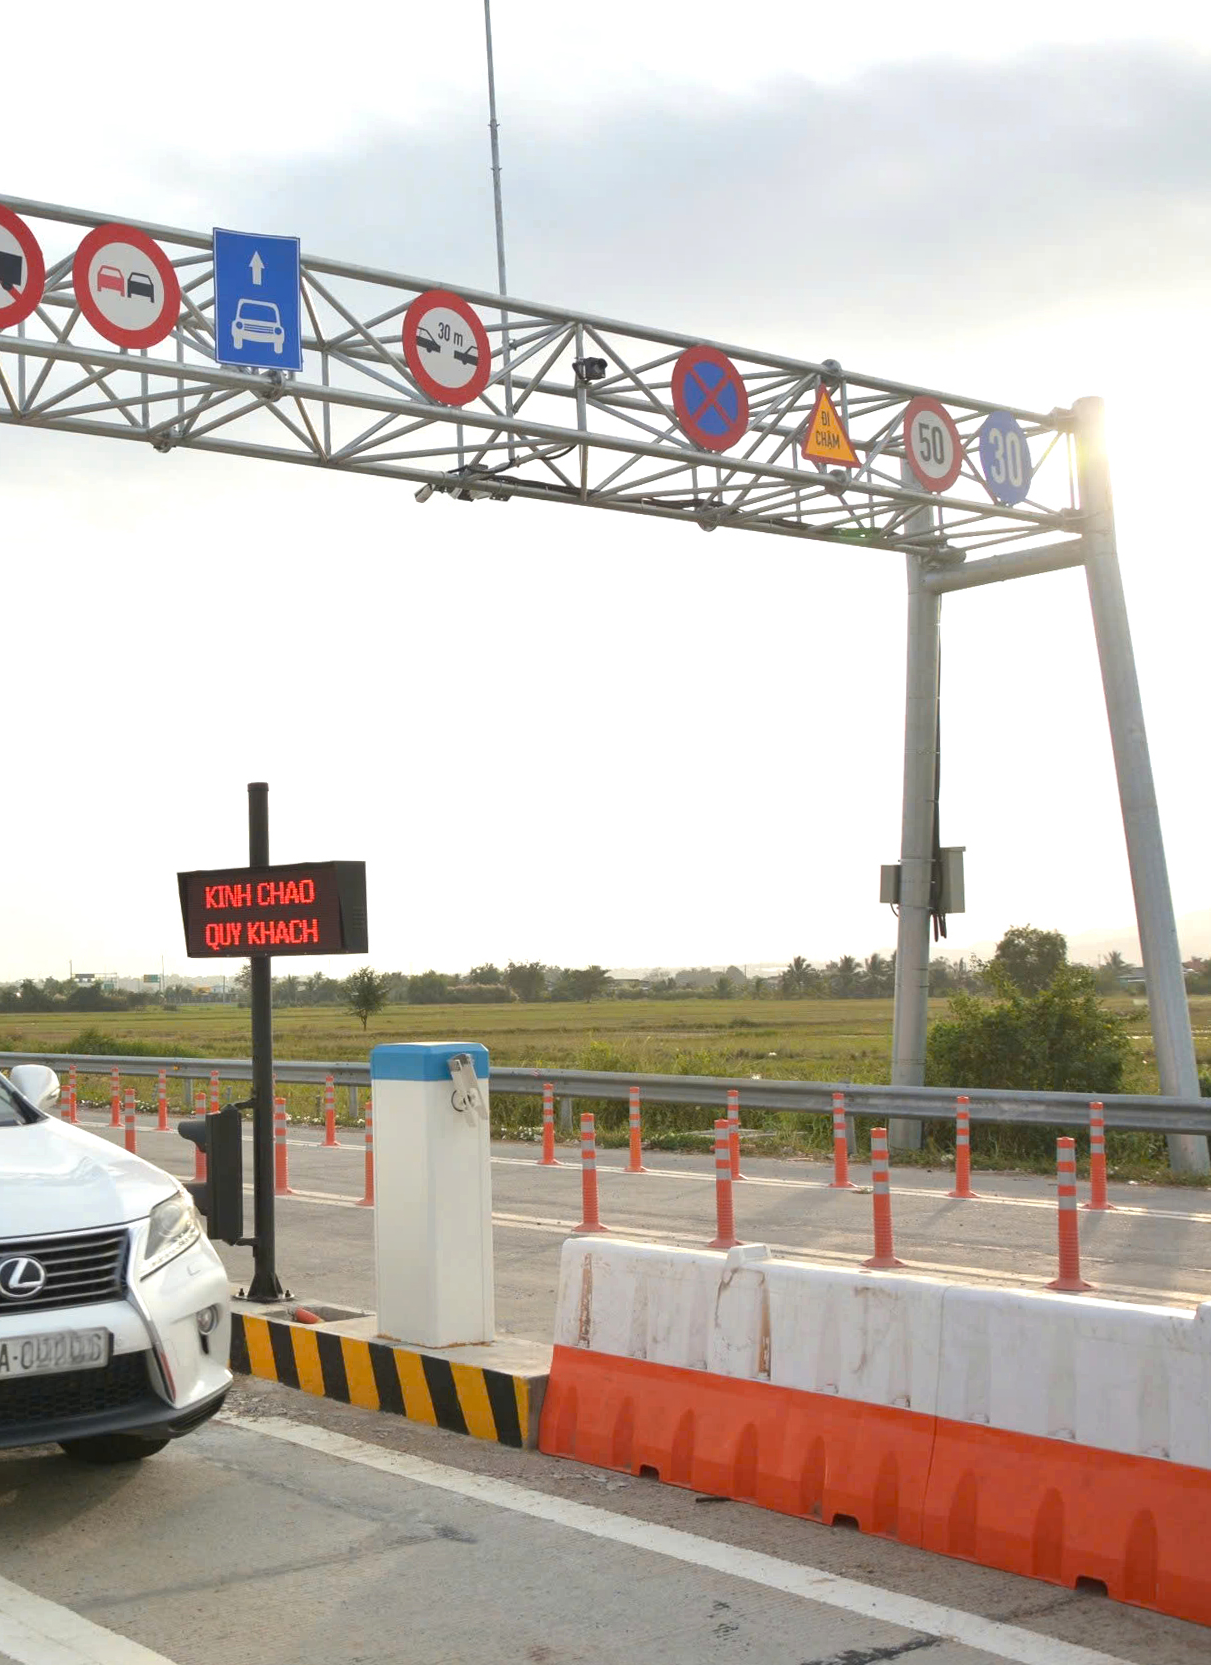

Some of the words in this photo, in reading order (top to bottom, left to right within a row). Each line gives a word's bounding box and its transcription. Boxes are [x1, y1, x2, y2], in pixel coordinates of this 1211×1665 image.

[438, 322, 450, 342] 30
[453, 332, 463, 347] m
[918, 422, 944, 465] 50
[989, 428, 1023, 487] 30
[205, 883, 251, 909] KINH
[257, 880, 316, 905] CHAO
[205, 923, 242, 951] QUY
[247, 919, 319, 944] KHACH
